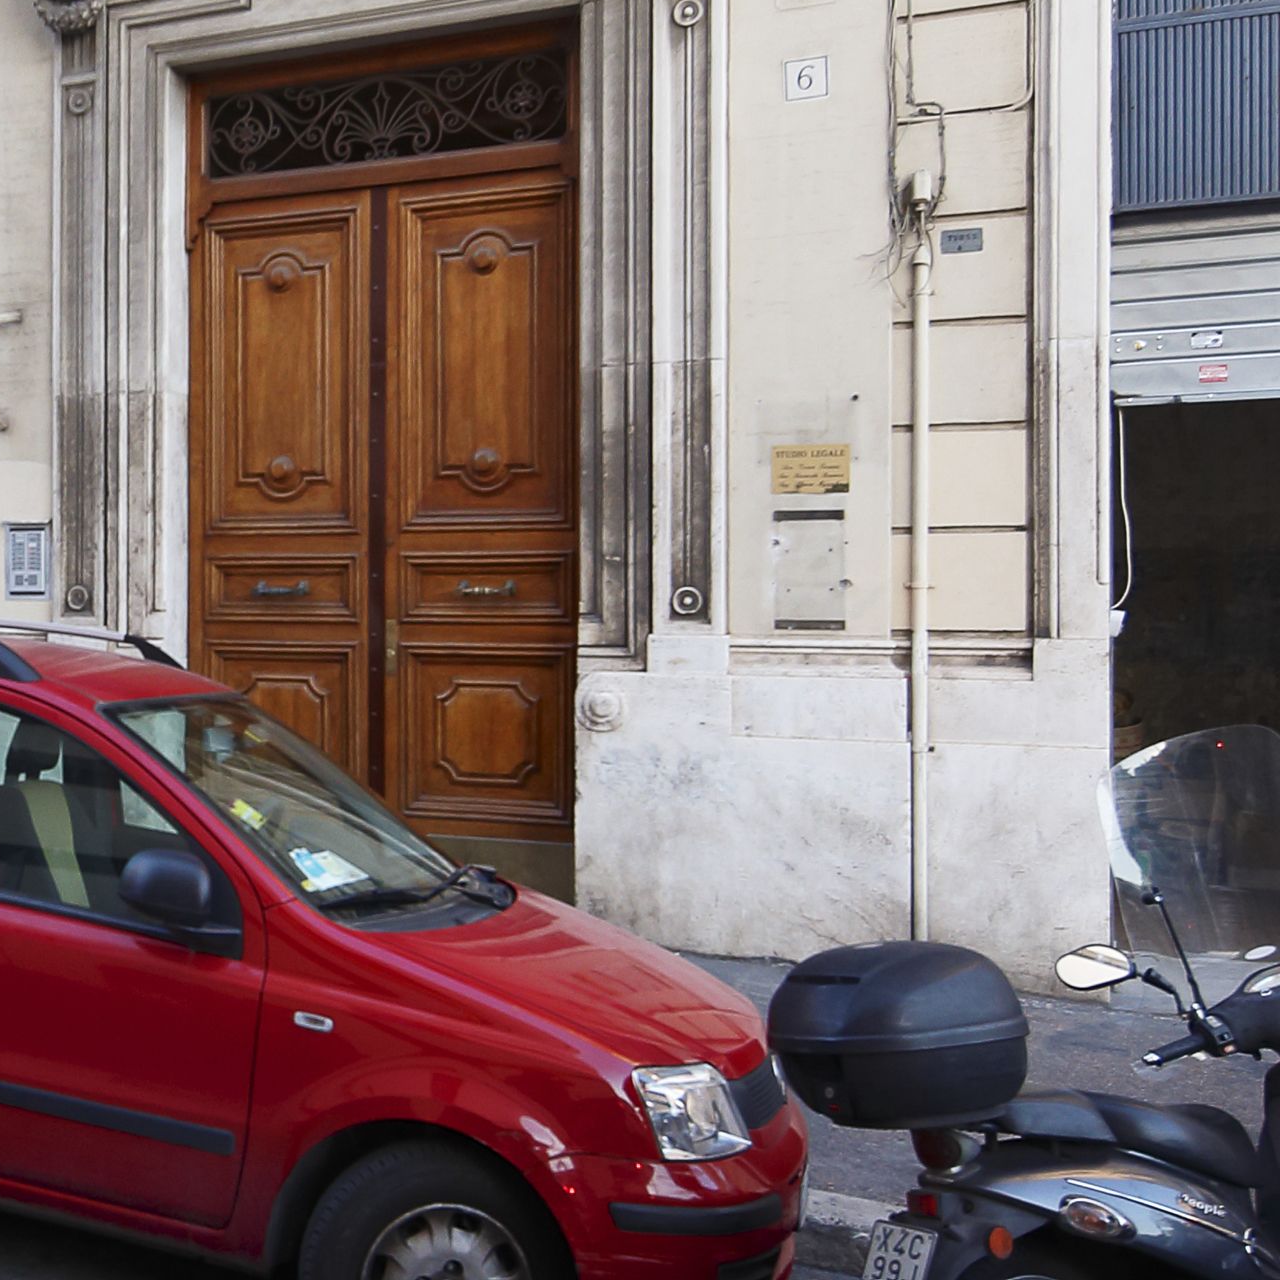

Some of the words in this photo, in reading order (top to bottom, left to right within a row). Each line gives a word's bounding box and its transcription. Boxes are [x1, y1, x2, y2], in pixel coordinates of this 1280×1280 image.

[797, 65, 814, 91] 6
[775, 450, 808, 459] STUDIO
[810, 449, 846, 458] LEGALE
